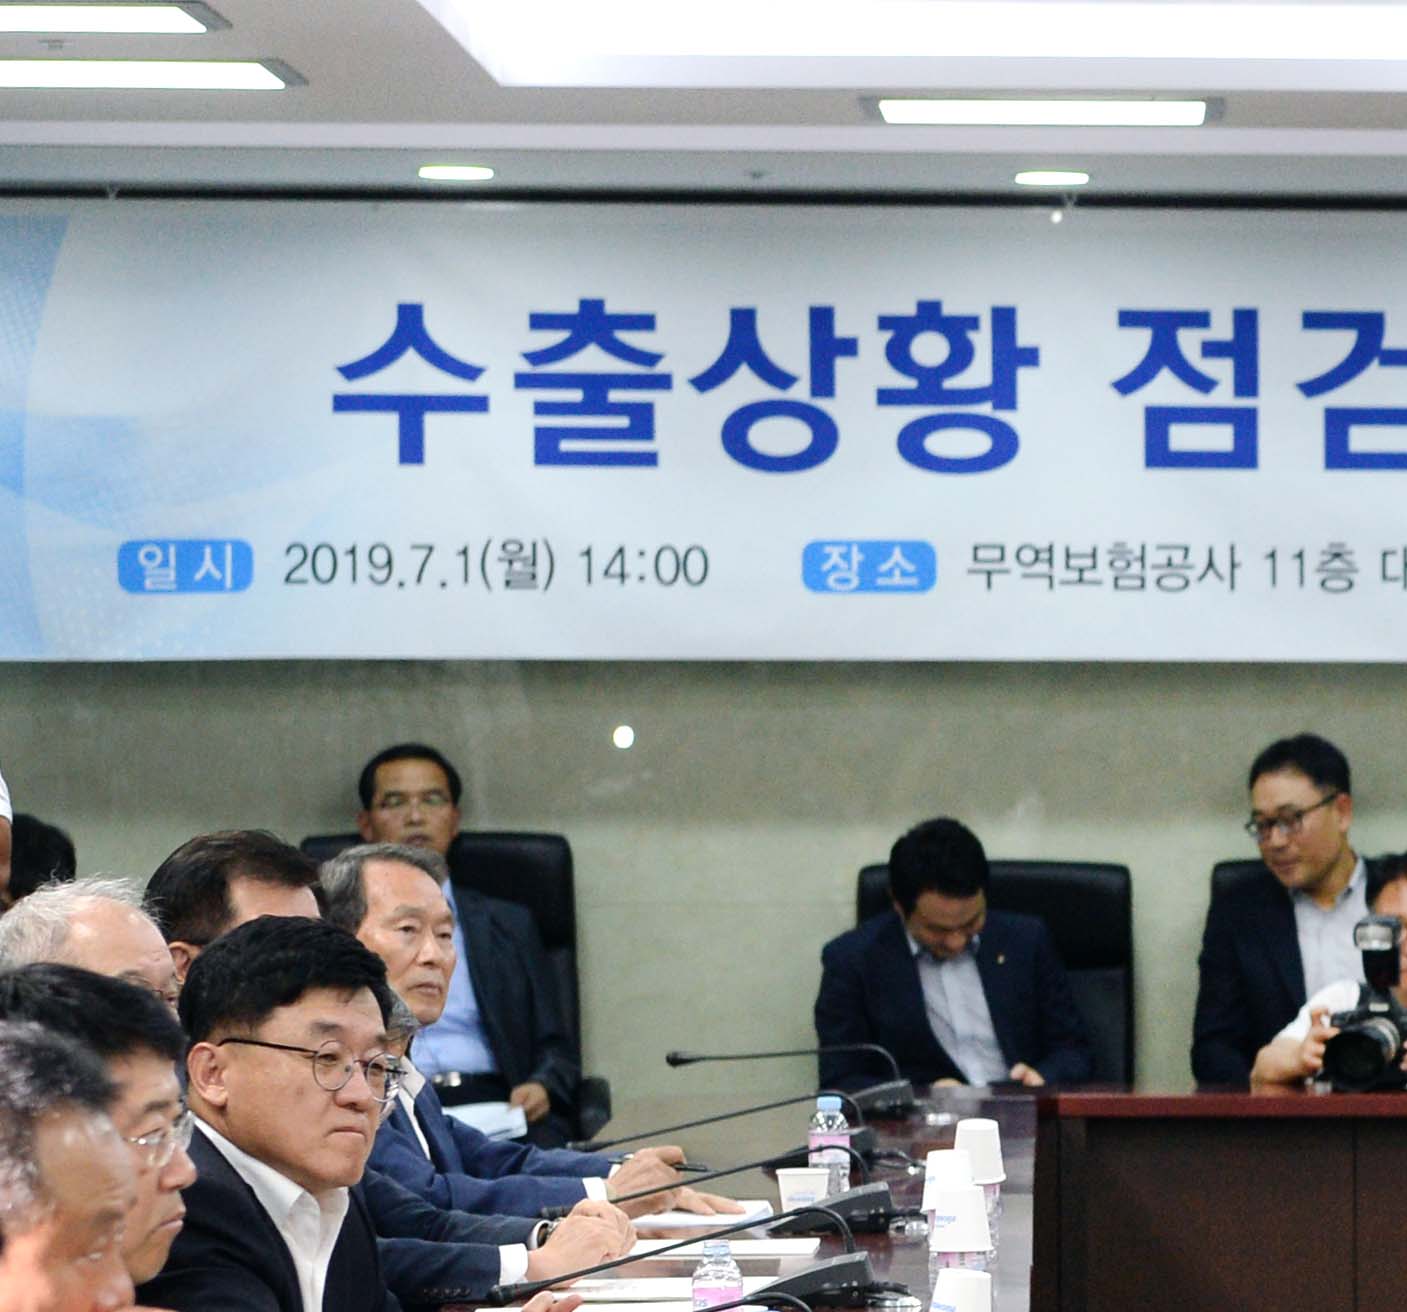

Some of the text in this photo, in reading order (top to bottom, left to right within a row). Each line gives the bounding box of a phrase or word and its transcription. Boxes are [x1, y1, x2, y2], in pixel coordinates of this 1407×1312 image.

[331, 297, 1040, 475] 수출상황
[282, 538, 557, 592] 2019.7.1(월)
[578, 544, 711, 588] 14:00
[965, 542, 1243, 594] 무역보험공사
[1264, 543, 1359, 594] 11층
